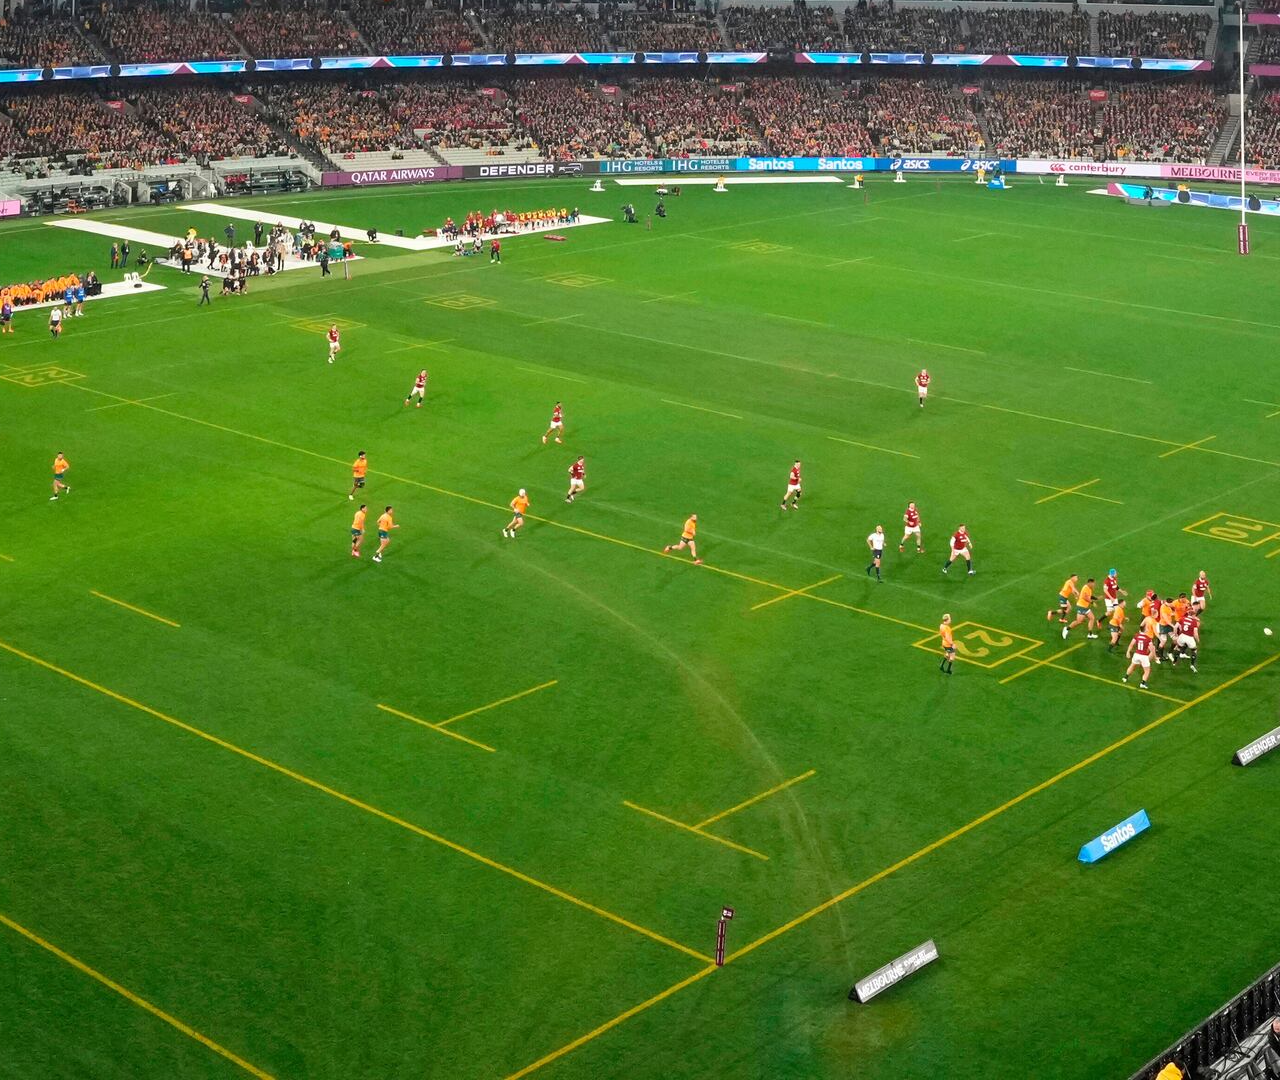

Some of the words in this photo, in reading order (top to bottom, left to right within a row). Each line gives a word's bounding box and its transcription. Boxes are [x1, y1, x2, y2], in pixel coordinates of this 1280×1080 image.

[479, 163, 554, 176] DEFENDER
[606, 160, 632, 172] IHG
[672, 159, 698, 170] IHG
[748, 158, 795, 170] Santos
[817, 158, 864, 170] Santos
[1069, 162, 1126, 175] canterbury
[351, 170, 388, 183] QATAR
[389, 167, 435, 180] AIRWAYS
[1170, 166, 1242, 180] MELBOURNE
[1240, 734, 1277, 763] DEFENDER
[1100, 821, 1136, 852] Santos
[857, 963, 906, 1000] MELBOURNE
